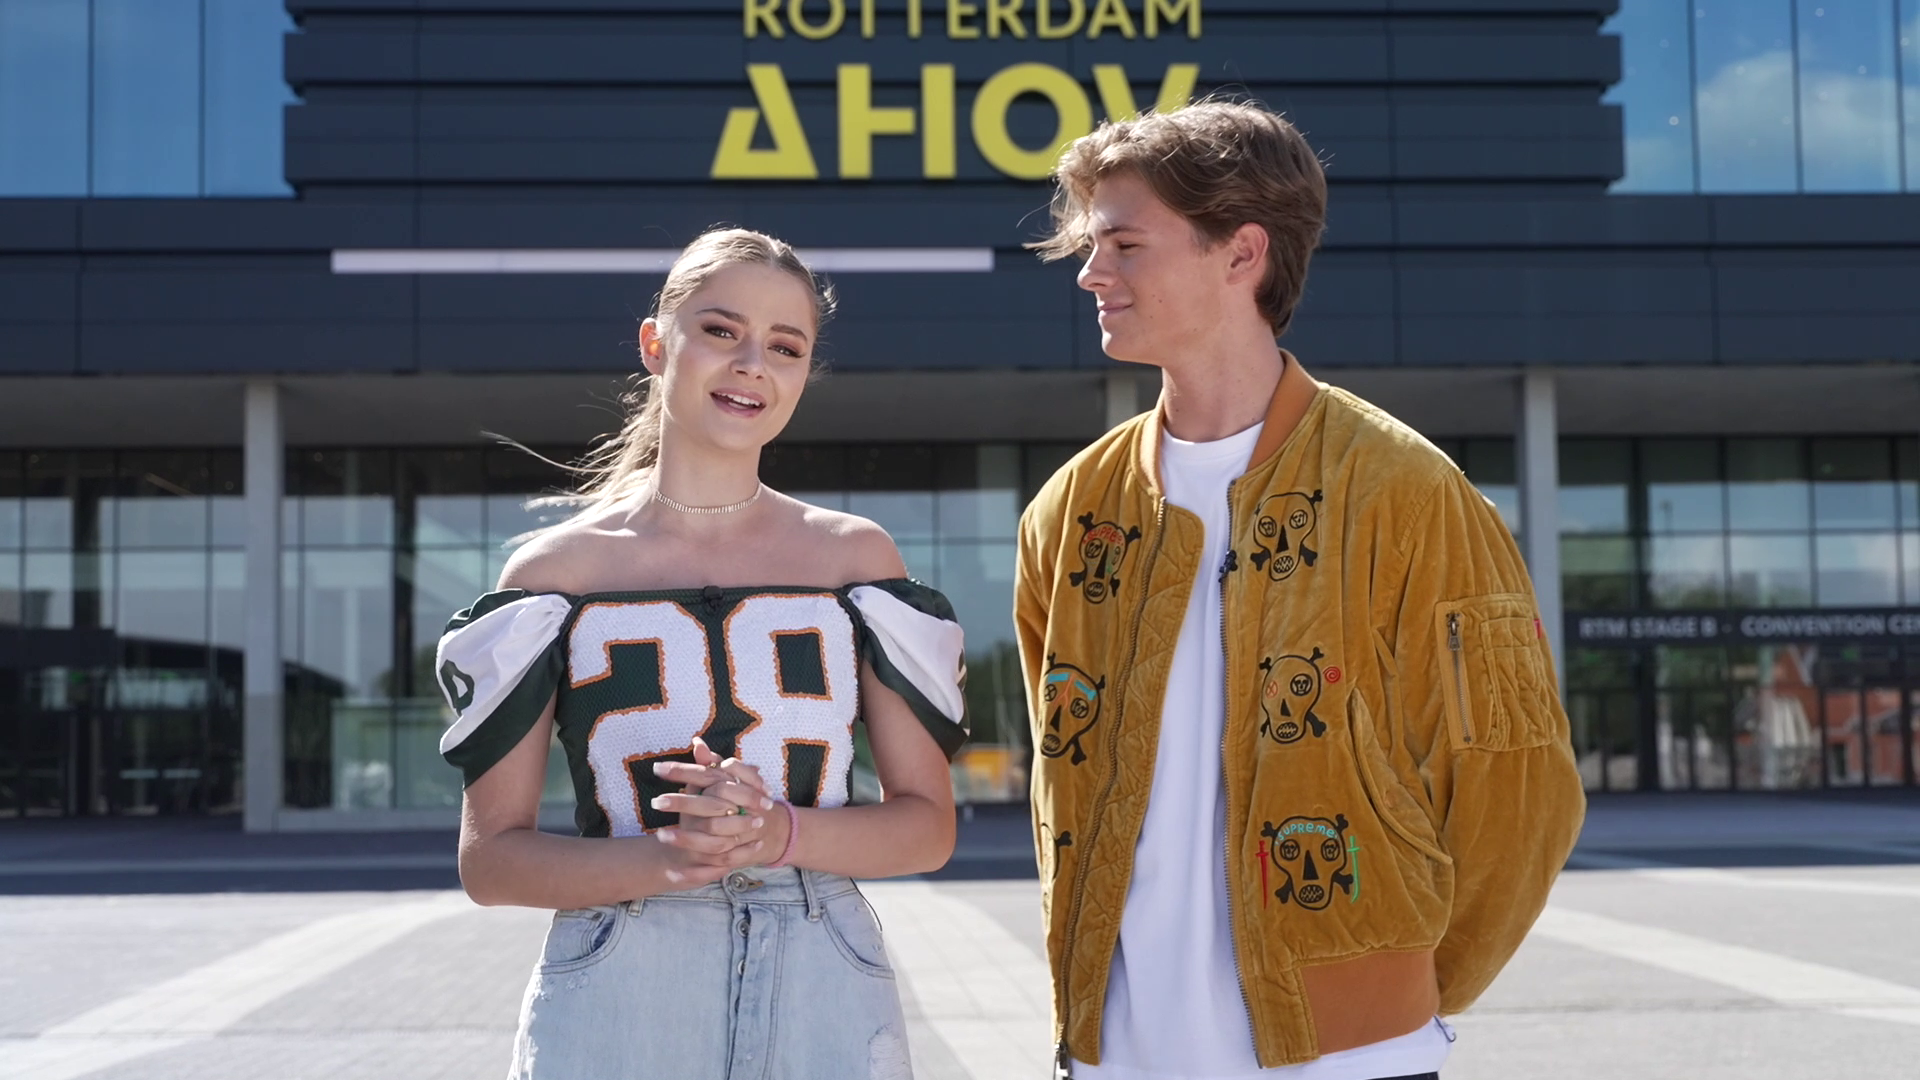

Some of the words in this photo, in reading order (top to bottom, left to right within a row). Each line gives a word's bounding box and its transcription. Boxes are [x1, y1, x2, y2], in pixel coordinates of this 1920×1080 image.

[743, 0, 1201, 39] ROTTERDAM
[1630, 615, 1698, 638] STAGE
[1740, 614, 1885, 637] CONVENTION
[1887, 613, 1920, 636] CE
[568, 592, 860, 838] 28
